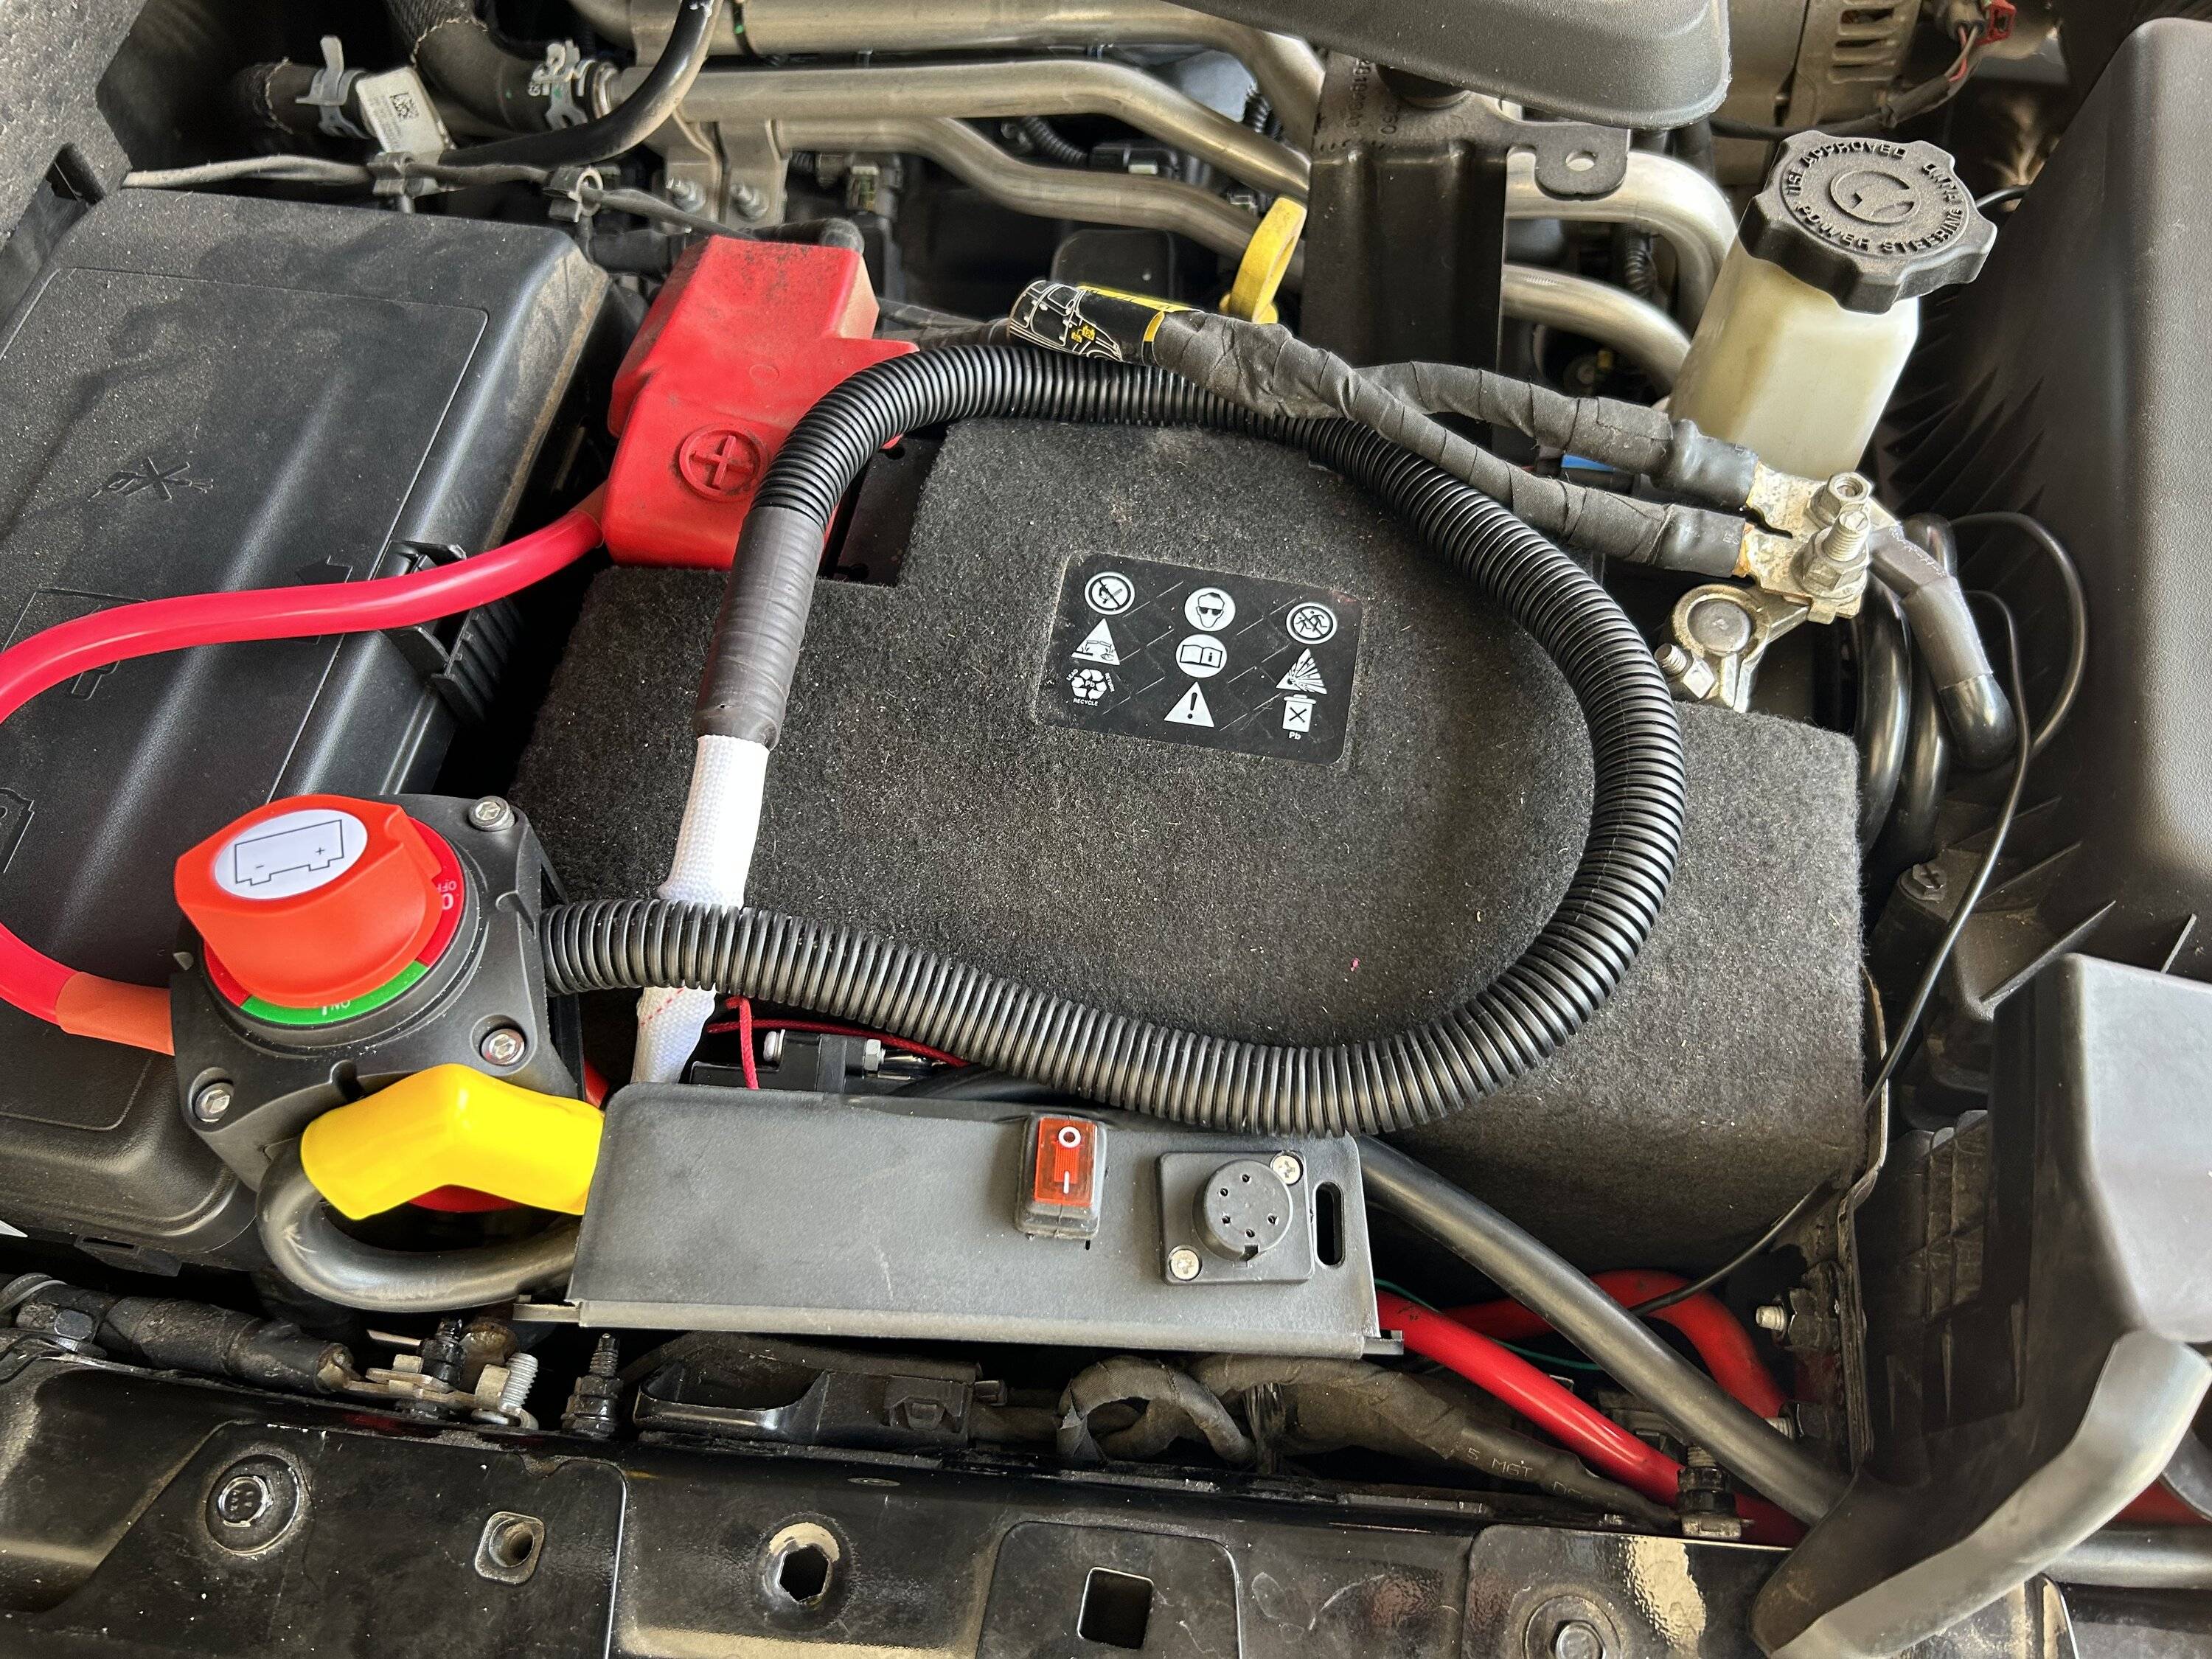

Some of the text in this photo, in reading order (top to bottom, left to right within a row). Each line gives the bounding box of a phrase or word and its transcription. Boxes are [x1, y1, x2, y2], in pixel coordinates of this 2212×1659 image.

[1800, 142, 1906, 167] APPROVED
[1797, 206, 1870, 251] POWER
[1881, 208, 1964, 253] STEERING
[1066, 669, 1078, 681] LEAD
[1105, 672, 1115, 692] RETURN
[1289, 731, 1301, 740] Pb
